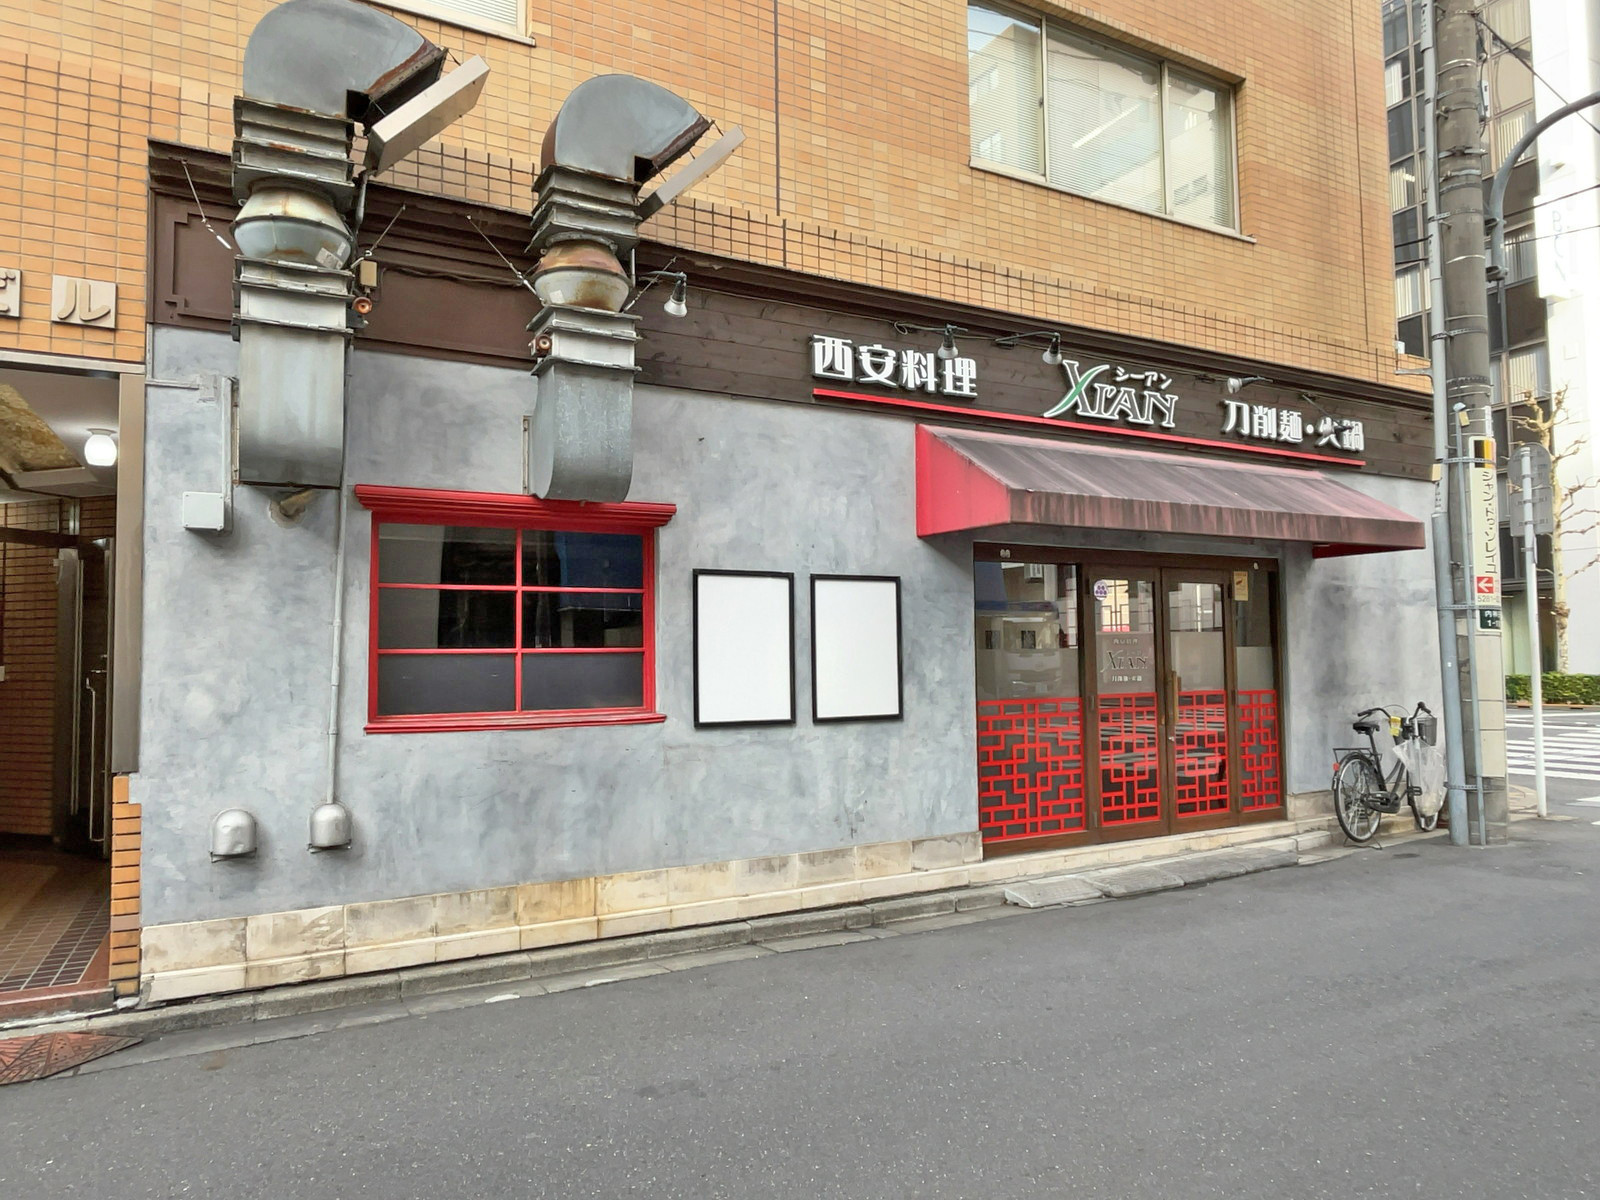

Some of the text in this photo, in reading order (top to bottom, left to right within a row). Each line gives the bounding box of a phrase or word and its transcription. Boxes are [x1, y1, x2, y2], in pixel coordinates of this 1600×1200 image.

[812, 334, 978, 397] 西安料理
[1115, 366, 1172, 389] シーアン
